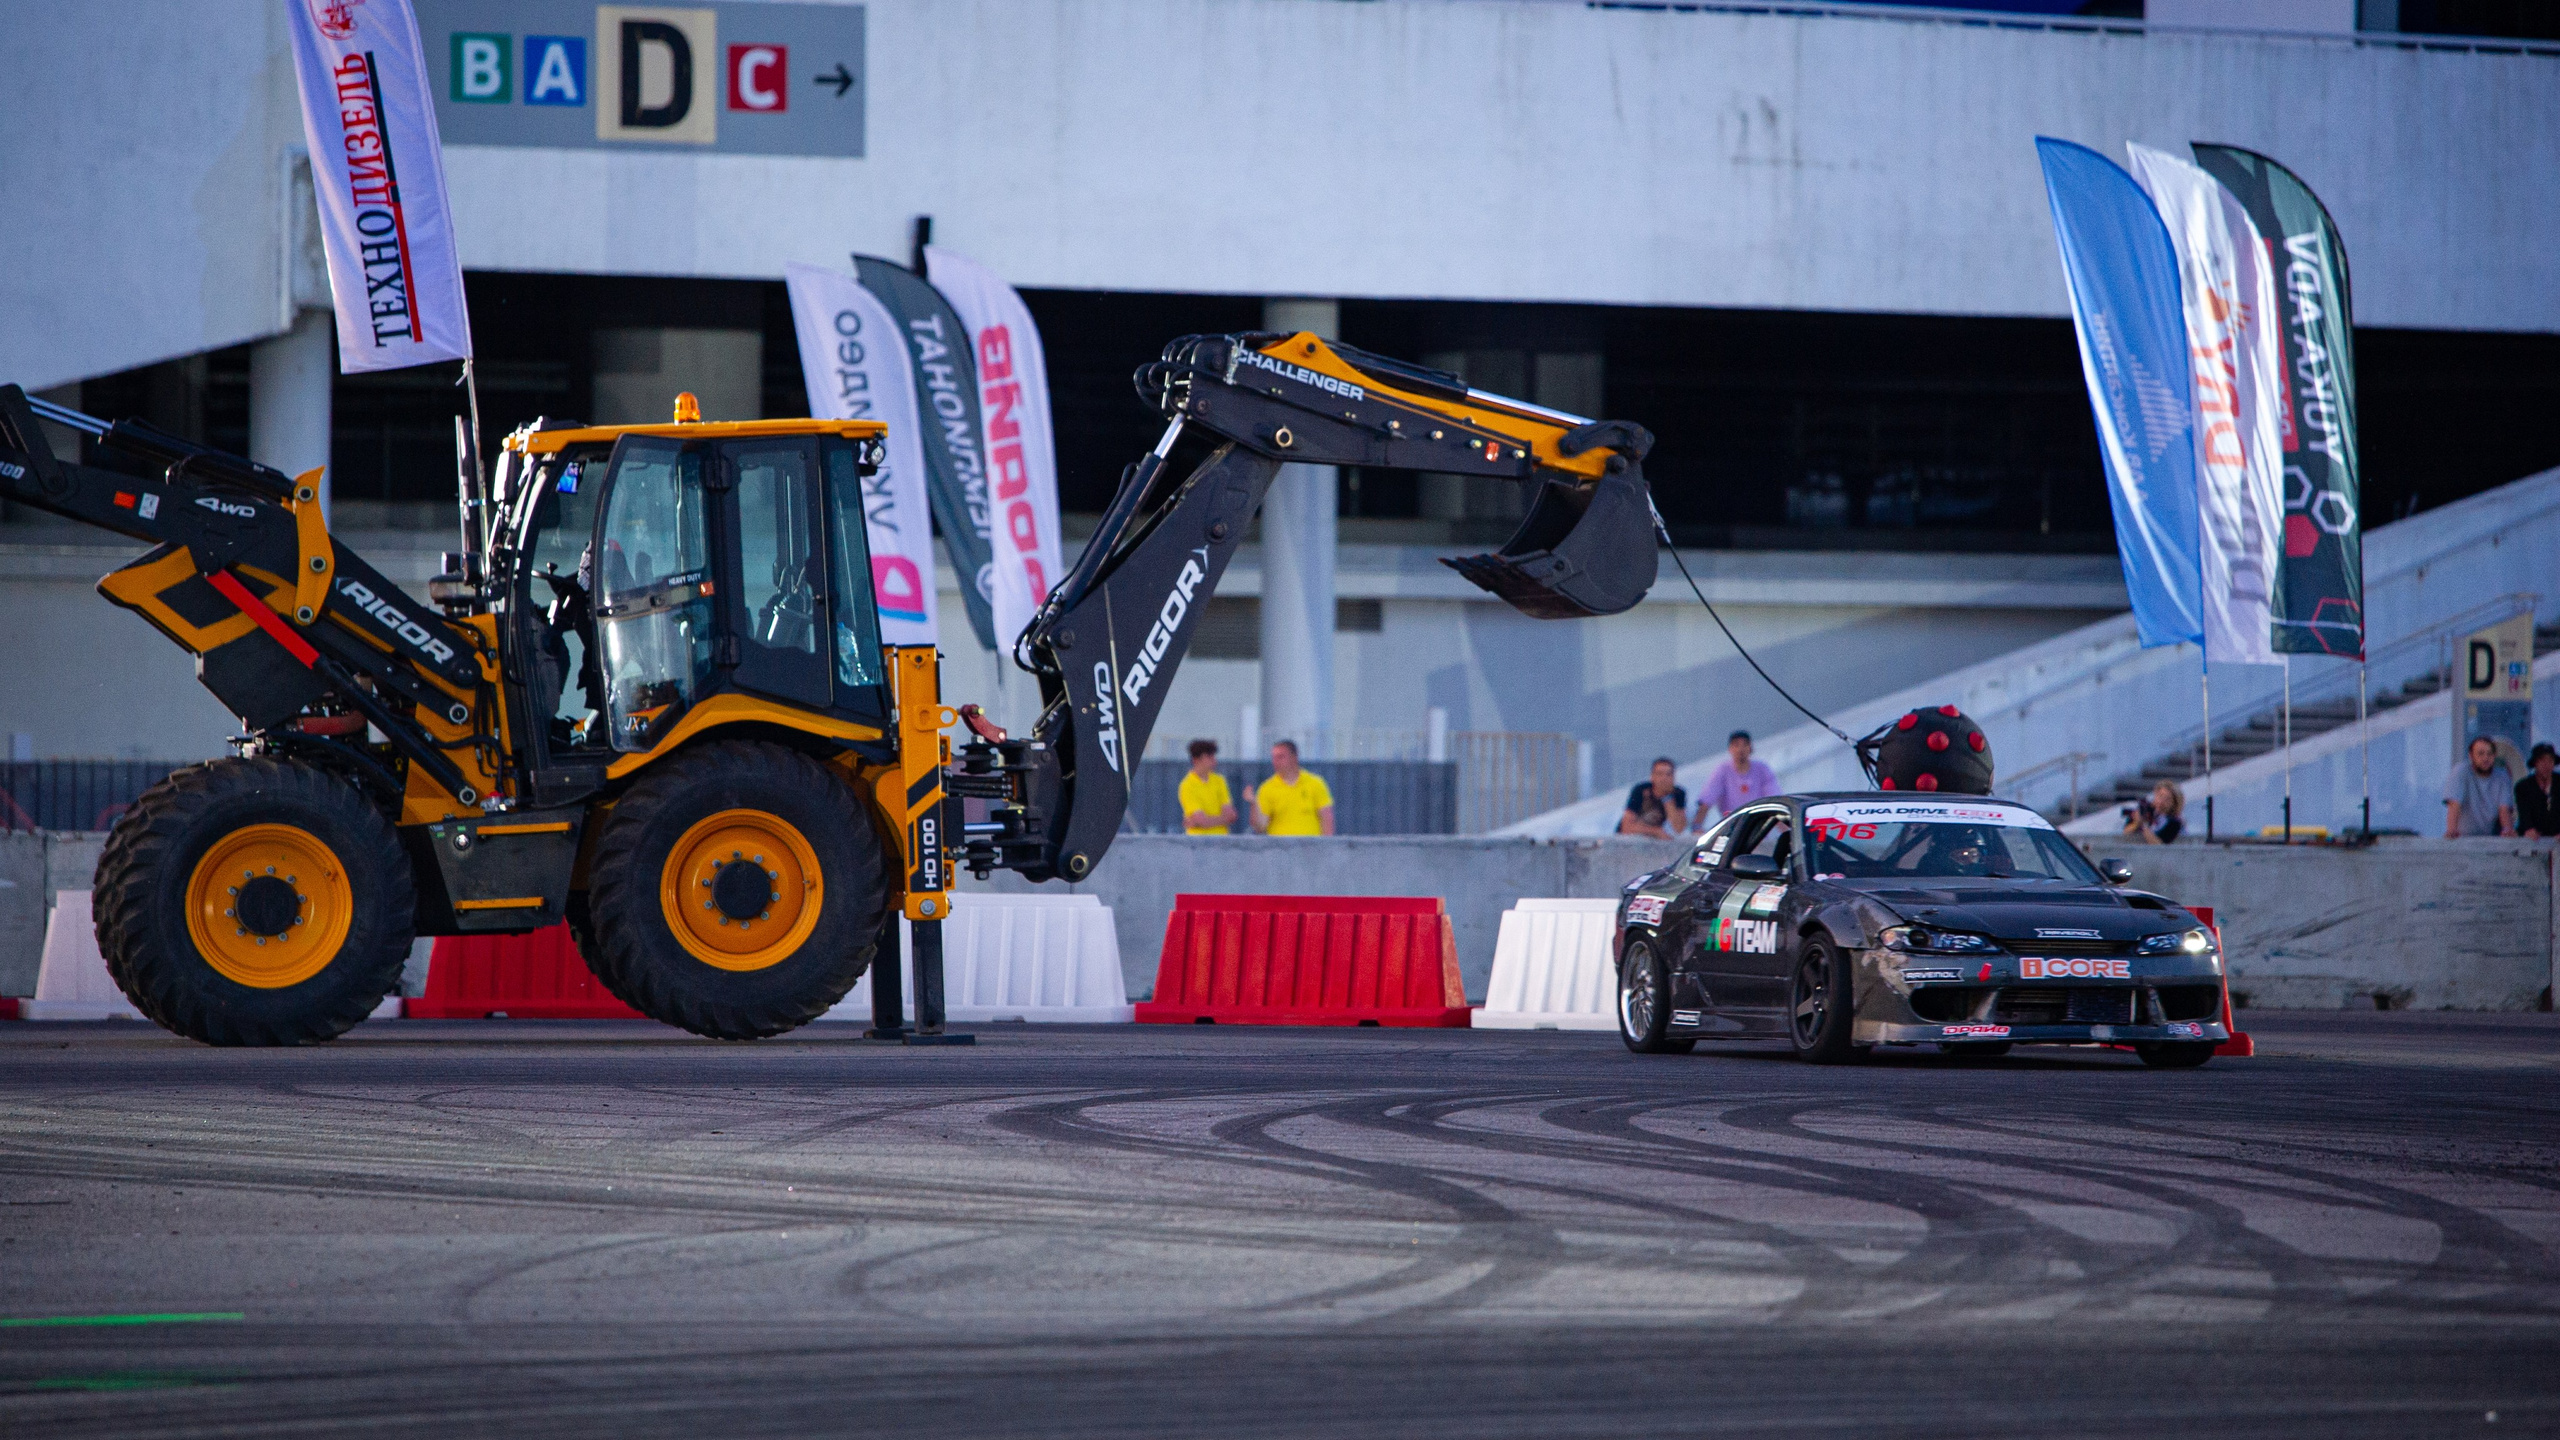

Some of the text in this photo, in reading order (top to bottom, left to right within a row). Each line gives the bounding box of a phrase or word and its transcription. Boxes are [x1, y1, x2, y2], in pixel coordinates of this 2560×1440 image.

[461, 18, 778, 128] B A D C
[334, 52, 412, 348] ТЕХНОДИЗЕЛЬ
[1237, 347, 1364, 402] CHALLENGER
[195, 497, 256, 519] 4WD
[341, 581, 455, 665] RIGOR
[1122, 559, 1205, 707] RIGOR
[2469, 641, 2495, 690] D
[1094, 661, 1120, 772] 4WD
[1808, 823, 1878, 843] 116
[1847, 808, 1891, 816] YUKA
[922, 818, 937, 888] HD 100
[1733, 919, 1778, 954] TEAM
